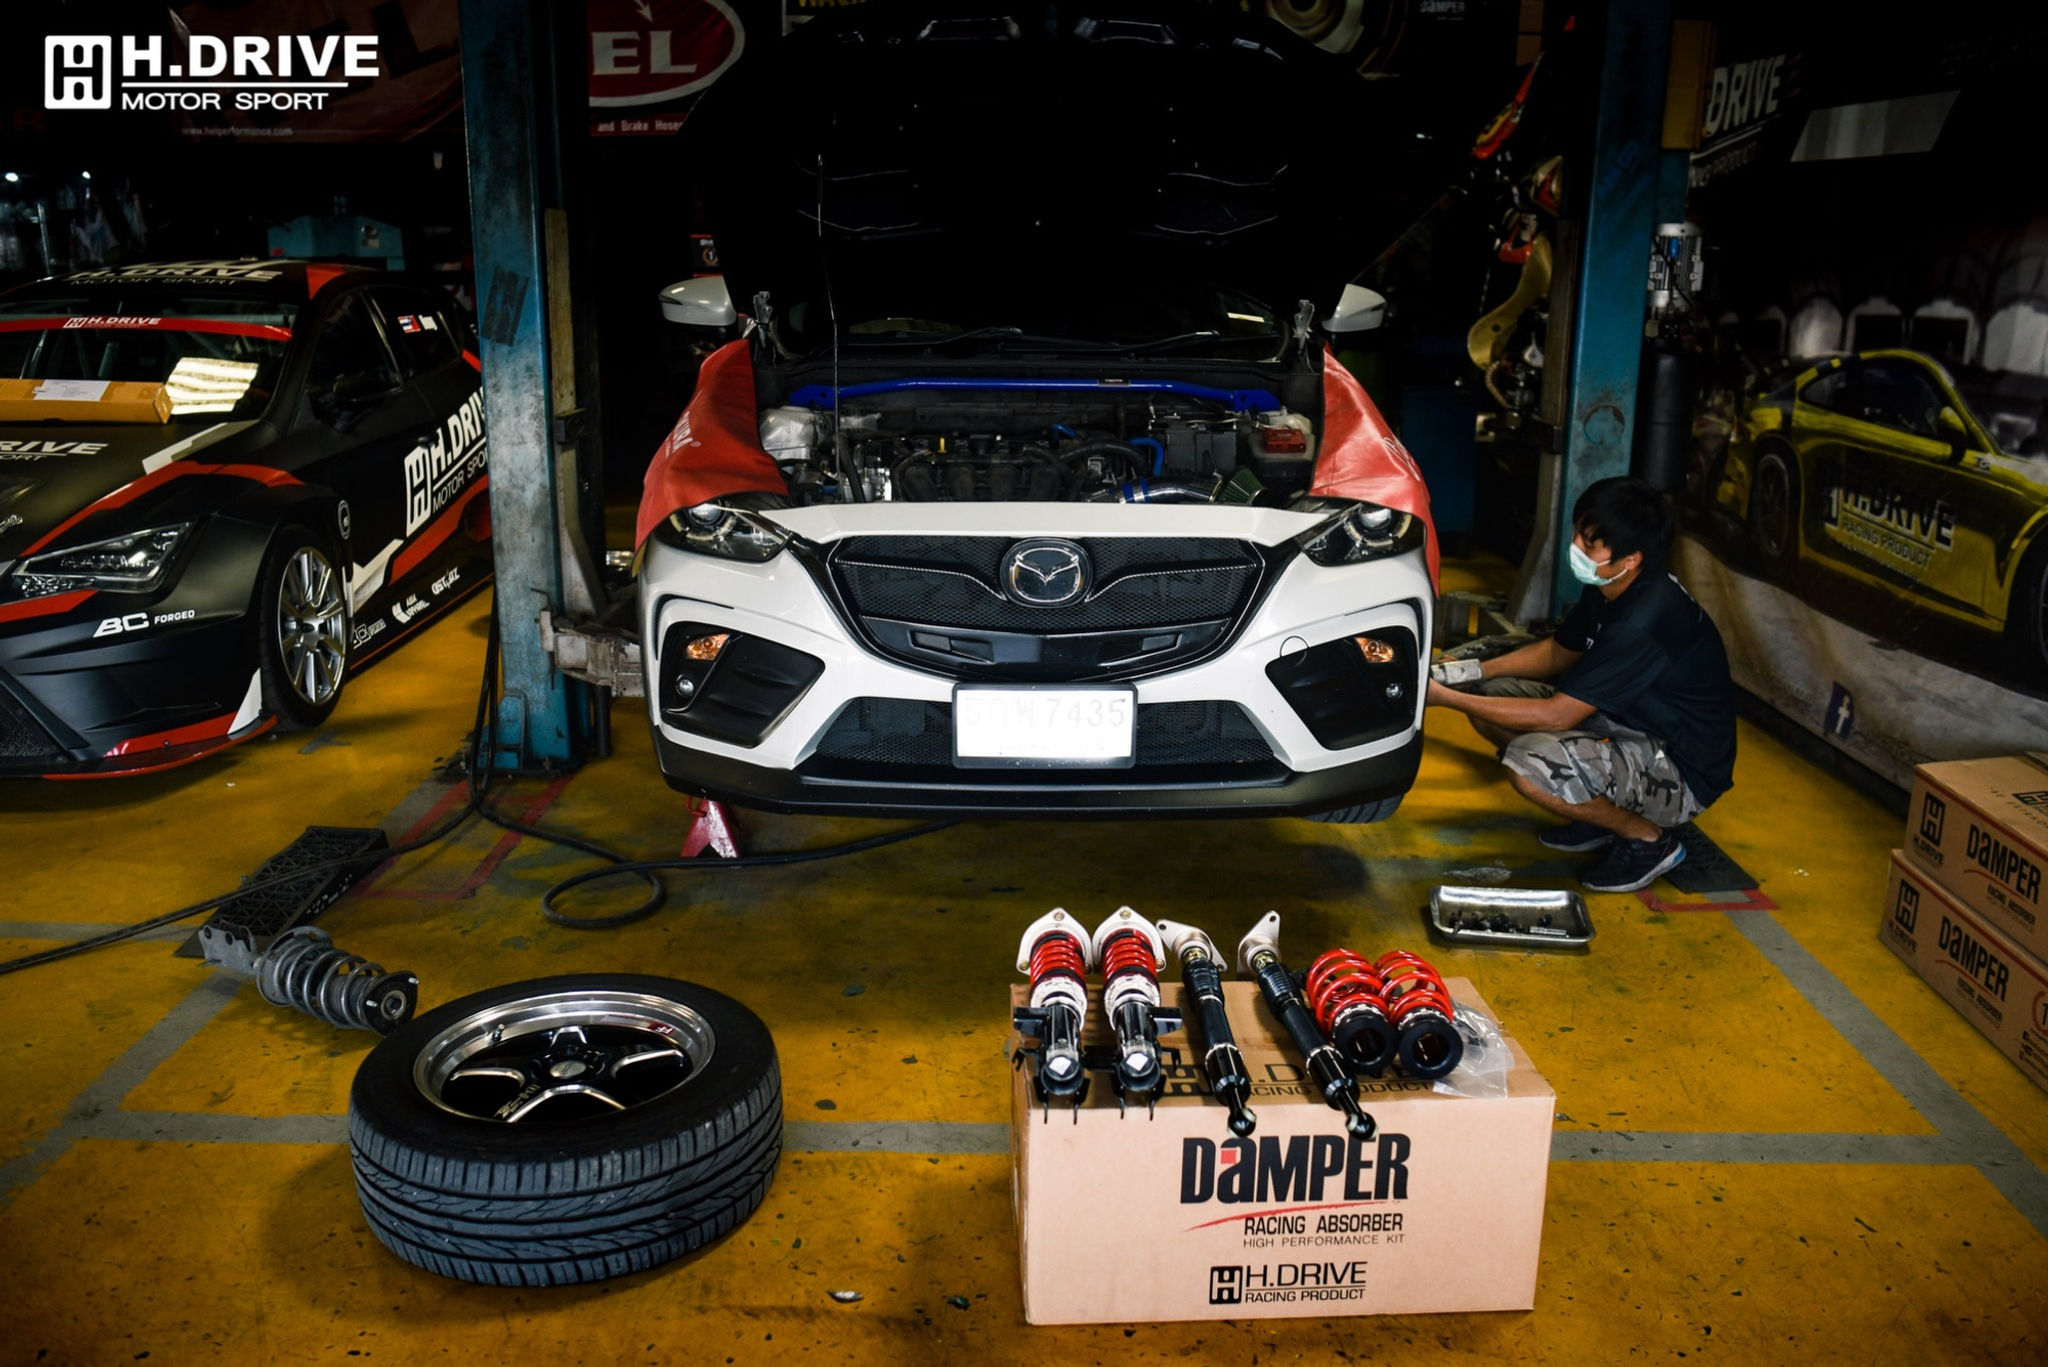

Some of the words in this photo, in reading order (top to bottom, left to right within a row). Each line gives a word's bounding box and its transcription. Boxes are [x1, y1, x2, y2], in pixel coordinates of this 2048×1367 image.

[597, 119, 616, 132] and
[620, 119, 649, 132] Brake
[432, 470, 465, 513] MOTOR
[92, 612, 150, 638] BC
[154, 609, 196, 625] FORGED
[1045, 696, 1127, 728] 7435
[1244, 1216, 1306, 1235] RACING
[1316, 1212, 1403, 1234] ABSORBER
[1243, 1238, 1274, 1248] HIGH
[1281, 1234, 1379, 1247] PERFORMANCE
[1386, 1233, 1405, 1244] KIT
[1245, 1261, 1368, 1288] H.DRIVE
[1245, 1290, 1296, 1304] RACING
[1300, 1288, 1366, 1302] PRODUCT
